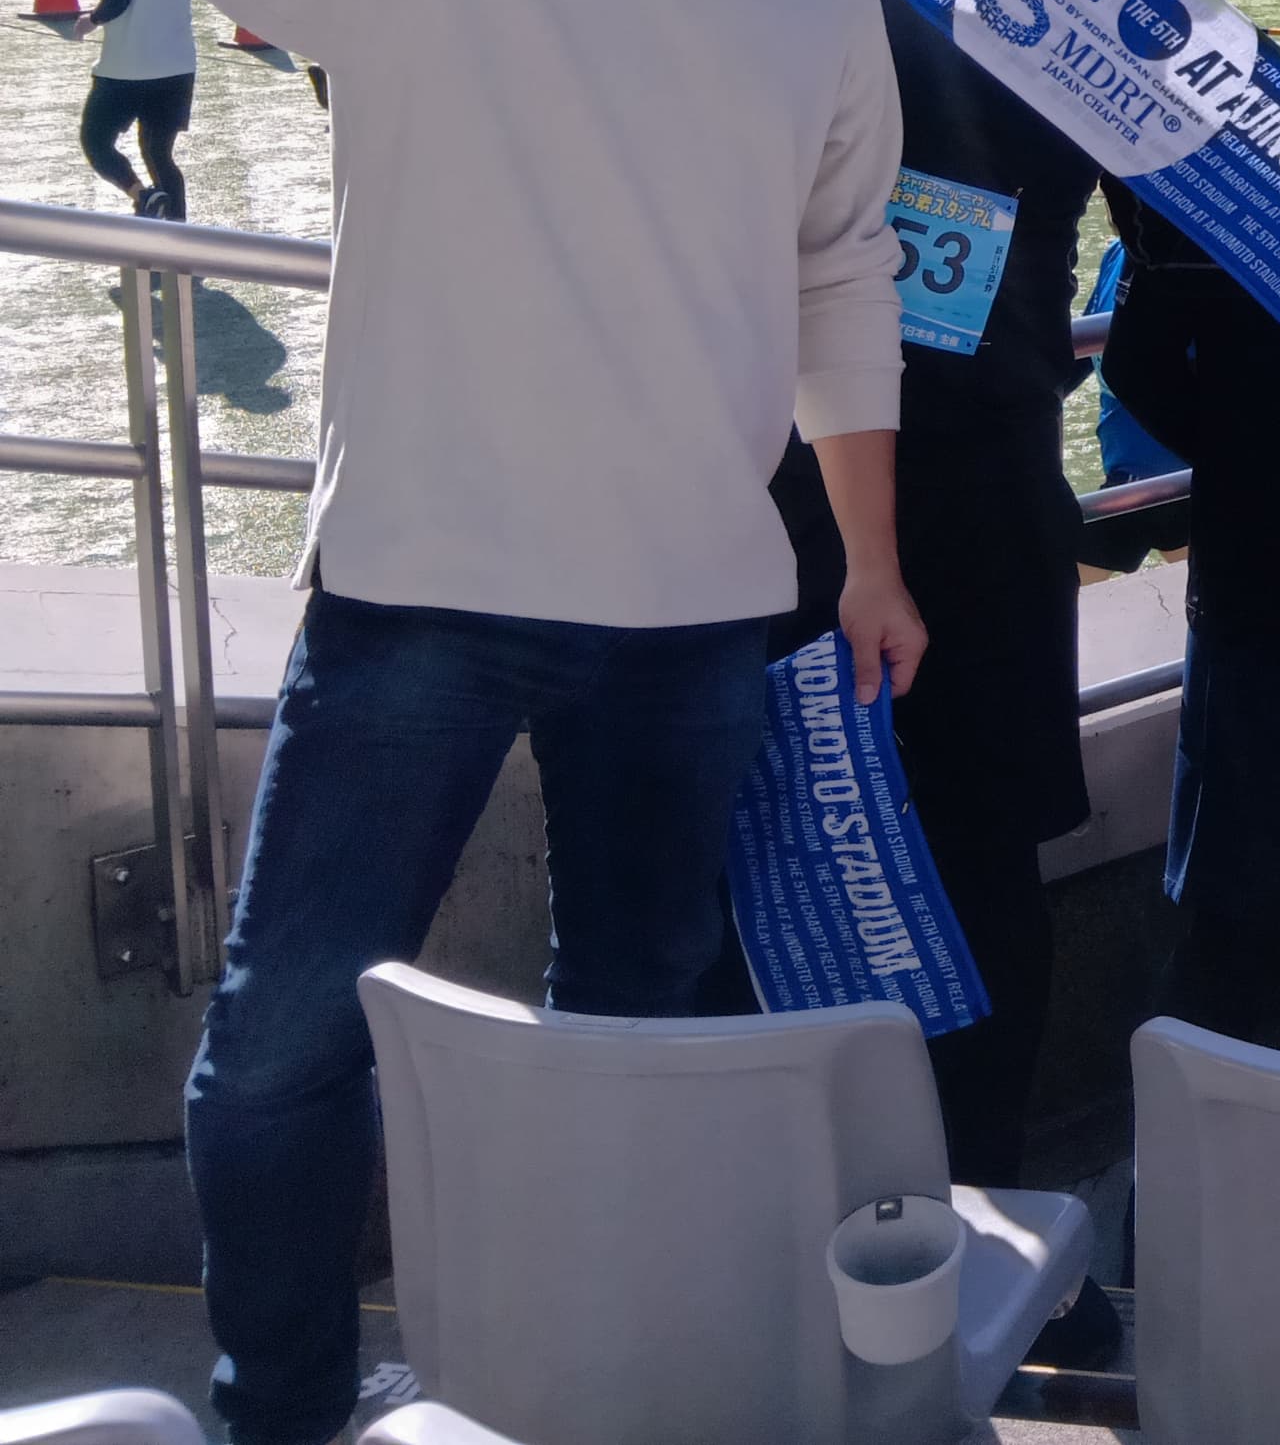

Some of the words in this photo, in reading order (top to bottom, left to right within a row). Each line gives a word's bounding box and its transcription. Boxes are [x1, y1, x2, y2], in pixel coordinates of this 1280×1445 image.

[1066, 4, 1083, 19] BY
[1081, 18, 1116, 47] MDRT
[1114, 48, 1150, 81] JAPAN
[1151, 78, 1204, 126] CHAPTER
[1151, 19, 1184, 51] 5TH
[1176, 50, 1243, 96] AT
[1042, 60, 1087, 96] JAPAN
[1083, 92, 1140, 146] CHAPTER
[1218, 130, 1252, 158] RELAY
[1195, 178, 1238, 215] STADIUM
[1238, 214, 1262, 235] THE
[1256, 229, 1279, 251] 5TH
[792, 636, 860, 804] NOMOTO
[822, 812, 922, 975] STADIUM
[868, 770, 901, 837] AJINOMOTO
[888, 835, 918, 886] STADIUM
[909, 892, 930, 915] THE
[930, 935, 958, 983] CHARITY
